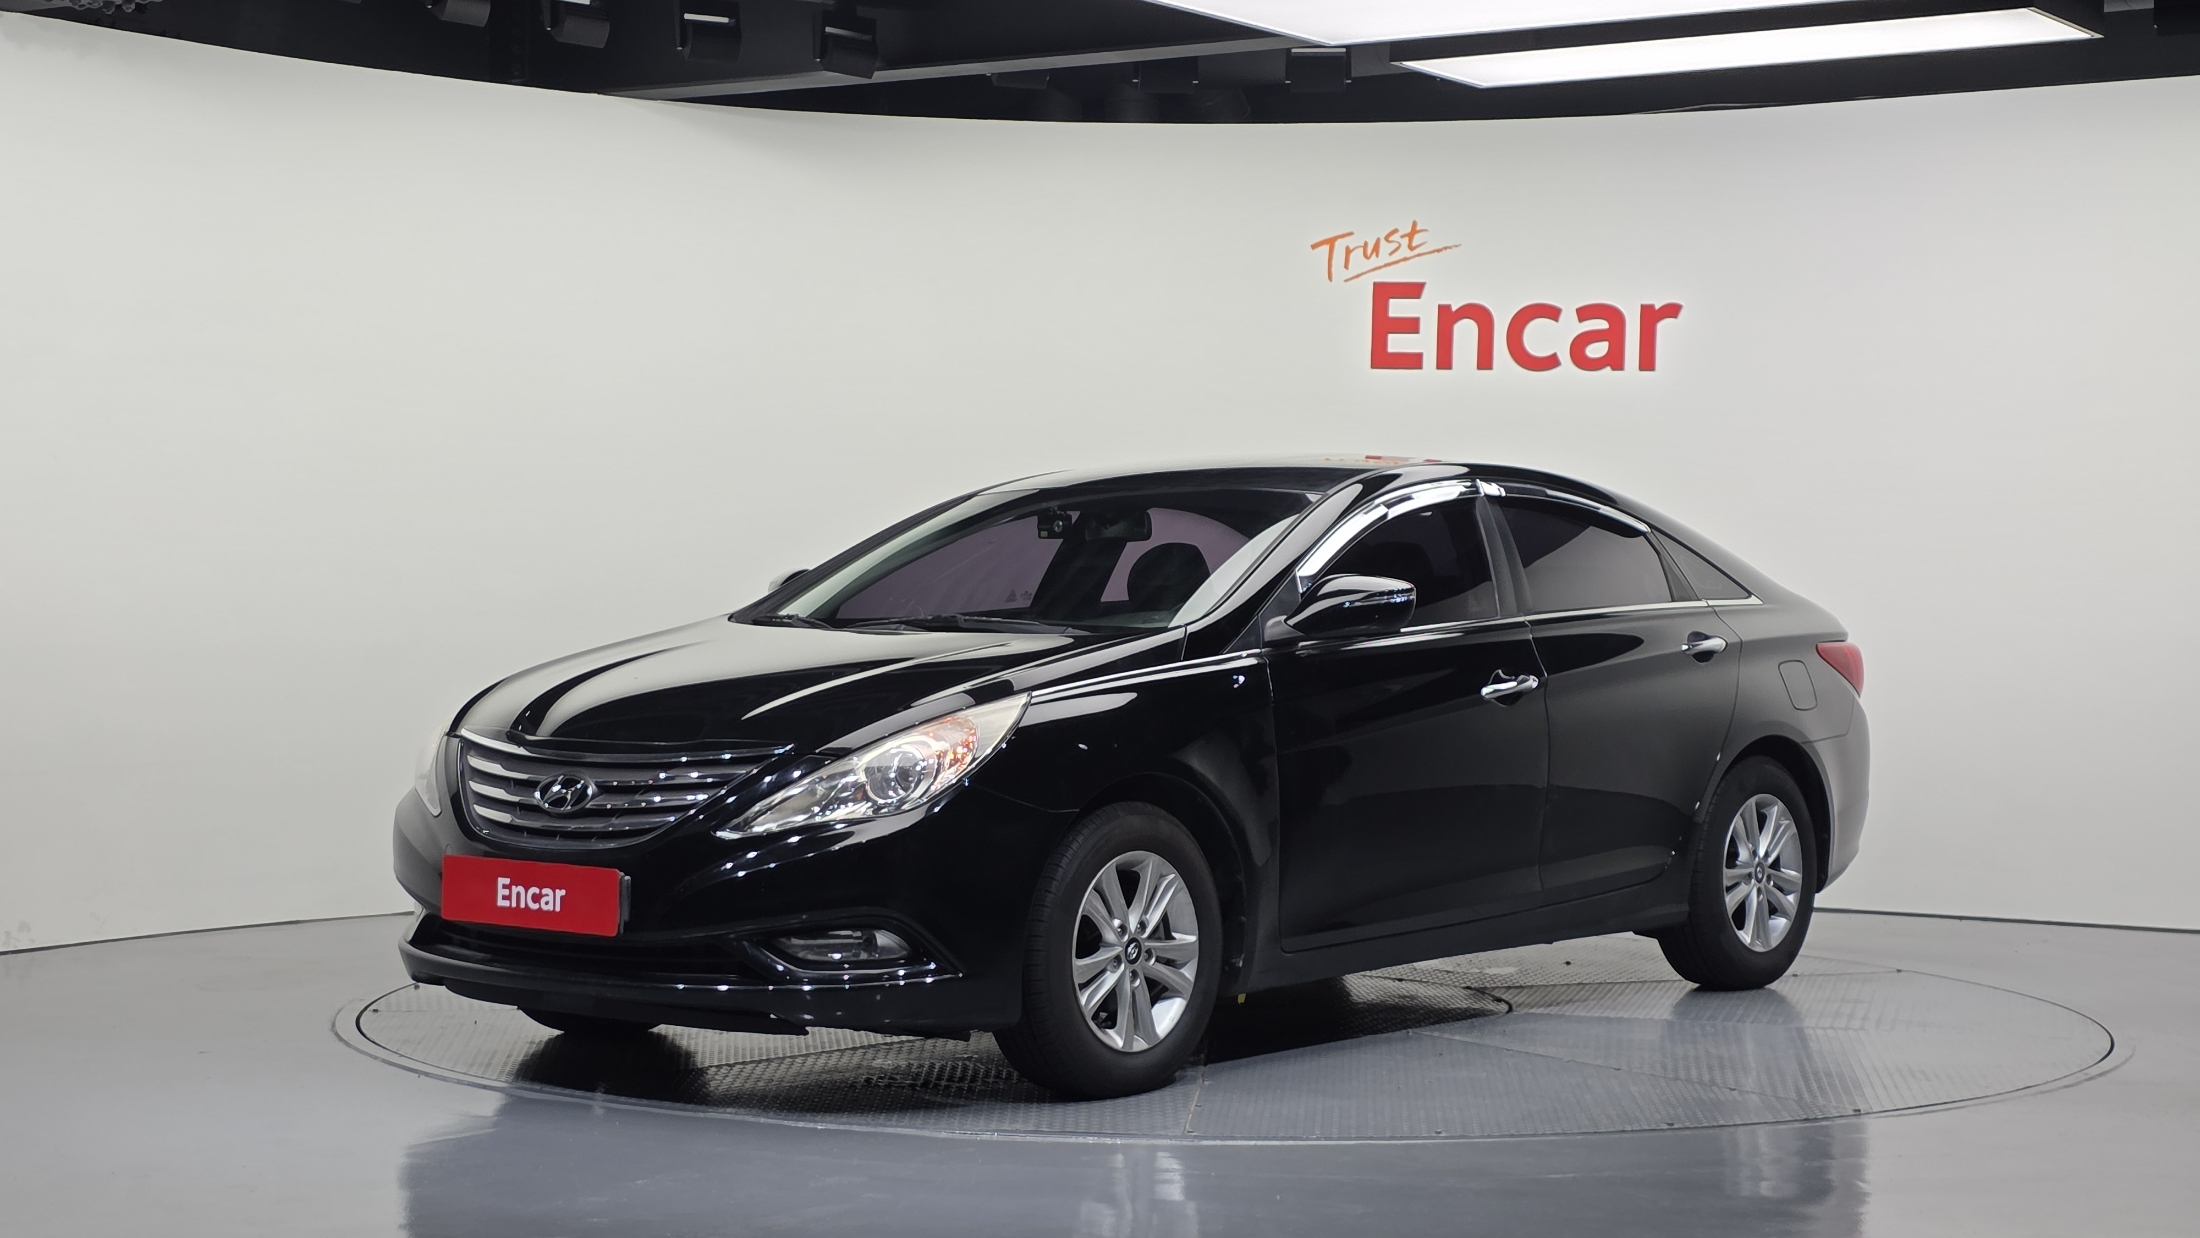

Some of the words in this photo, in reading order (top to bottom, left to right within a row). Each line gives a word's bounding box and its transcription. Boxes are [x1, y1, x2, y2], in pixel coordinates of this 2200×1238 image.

[1311, 220, 1429, 282] Trust
[1371, 281, 1683, 372] Encar
[497, 877, 566, 912] Encar
